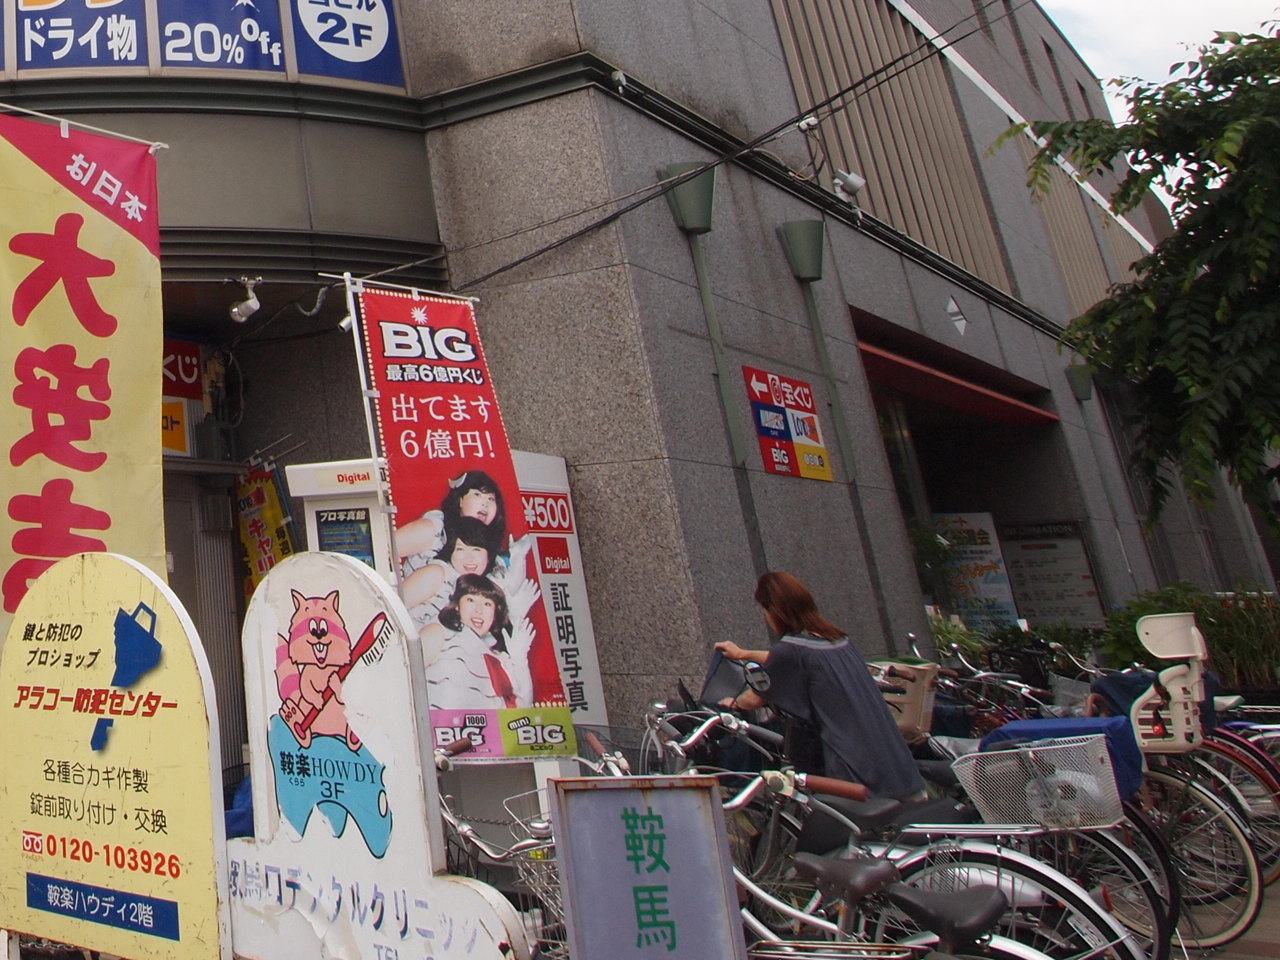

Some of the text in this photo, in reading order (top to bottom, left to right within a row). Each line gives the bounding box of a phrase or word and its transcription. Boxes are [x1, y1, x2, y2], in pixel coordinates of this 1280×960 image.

[319, 11, 374, 49] 2F
[379, 321, 476, 362] BIG
[386, 364, 485, 385] 最高6億円くじ
[391, 393, 491, 424] 出てます
[771, 447, 789, 464] BIG
[337, 472, 371, 484] Digital
[320, 510, 368, 522] プロ写真館
[521, 496, 570, 528] ¥500
[545, 556, 571, 573] Digital
[22, 622, 83, 642] 鍵と防犯の
[26, 648, 102, 668] プロショップ
[550, 582, 589, 713] 証明写真
[14, 685, 178, 717] アラコー防犯センター
[466, 715, 486, 727] 1000
[509, 718, 530, 730] mini
[434, 726, 485, 747] BIG
[517, 724, 567, 745] BIG
[43, 759, 150, 794] 各種合カギ作製
[311, 757, 378, 785] HOWDY
[320, 781, 345, 799] 3F
[46, 834, 182, 880] 0120-103926
[621, 806, 677, 952] 鞍馬
[47, 884, 154, 928] 鞍楽ハウディ2階
